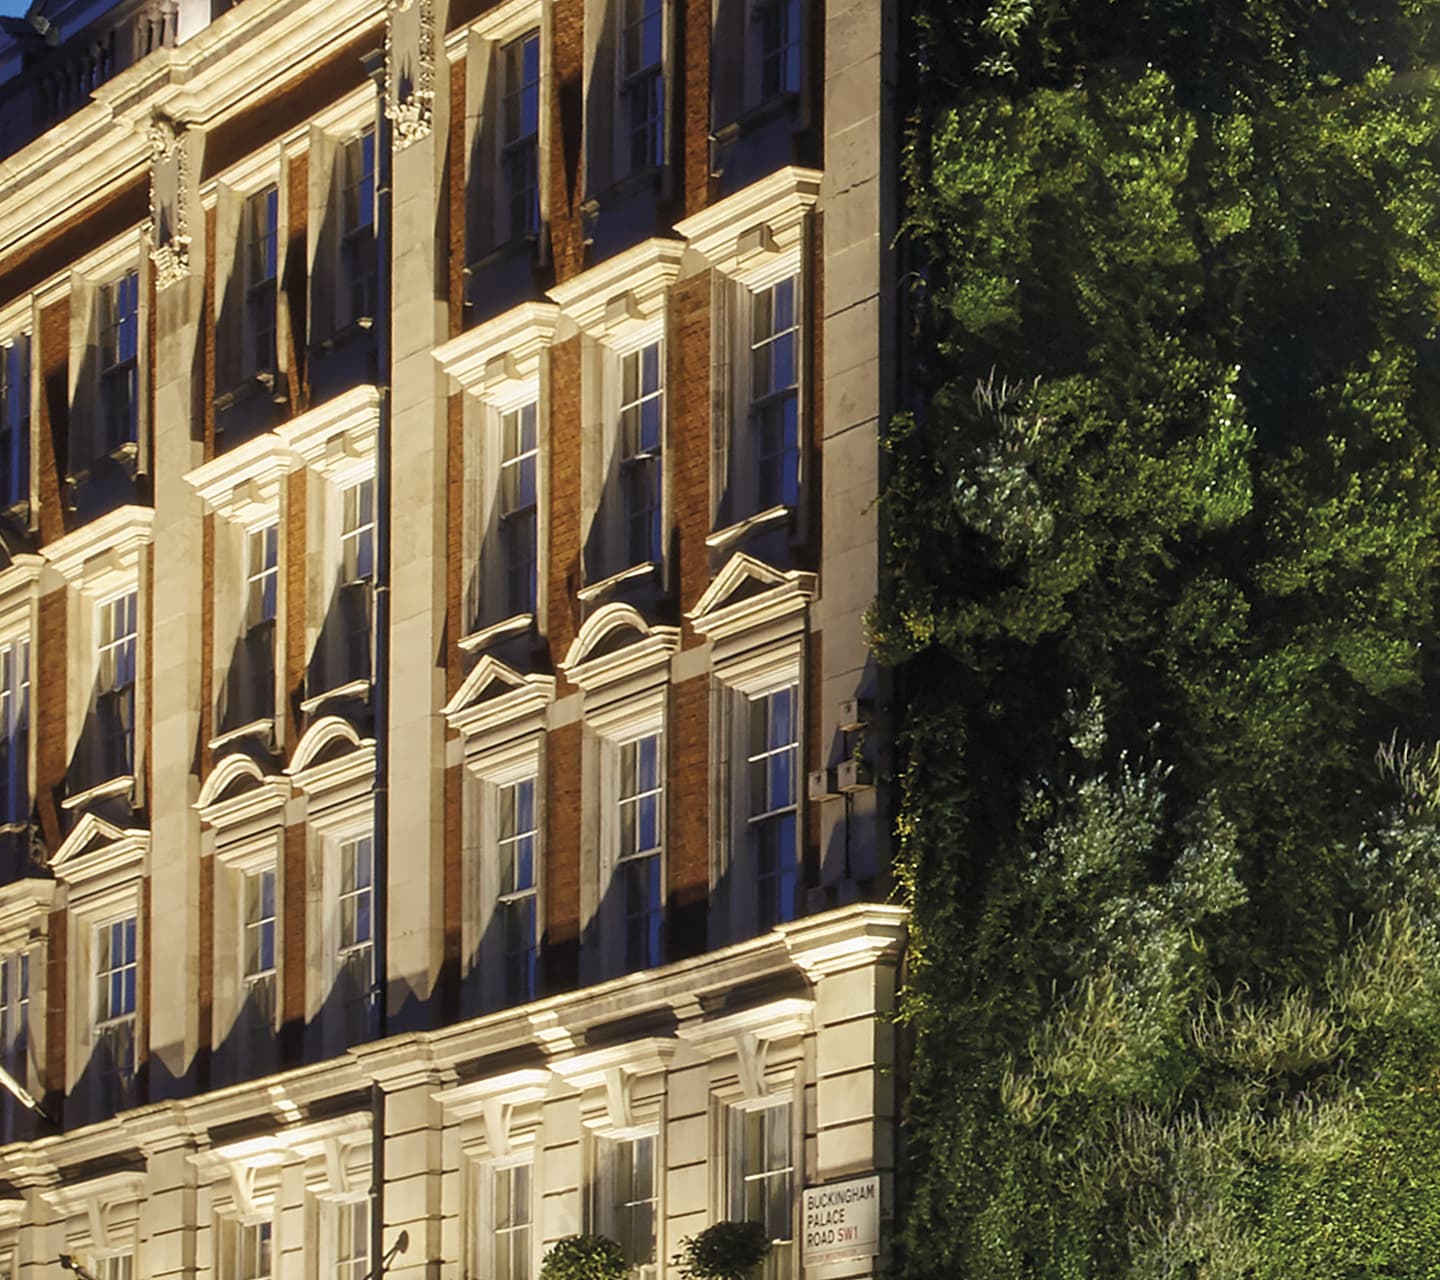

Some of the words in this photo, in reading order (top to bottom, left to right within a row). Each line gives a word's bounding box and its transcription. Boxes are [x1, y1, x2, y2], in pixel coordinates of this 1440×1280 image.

[808, 1184, 875, 1210] BUCKINGHAM
[807, 1208, 845, 1229] PALACE
[807, 1229, 835, 1248] ROAD
[837, 1225, 858, 1242] SW1
